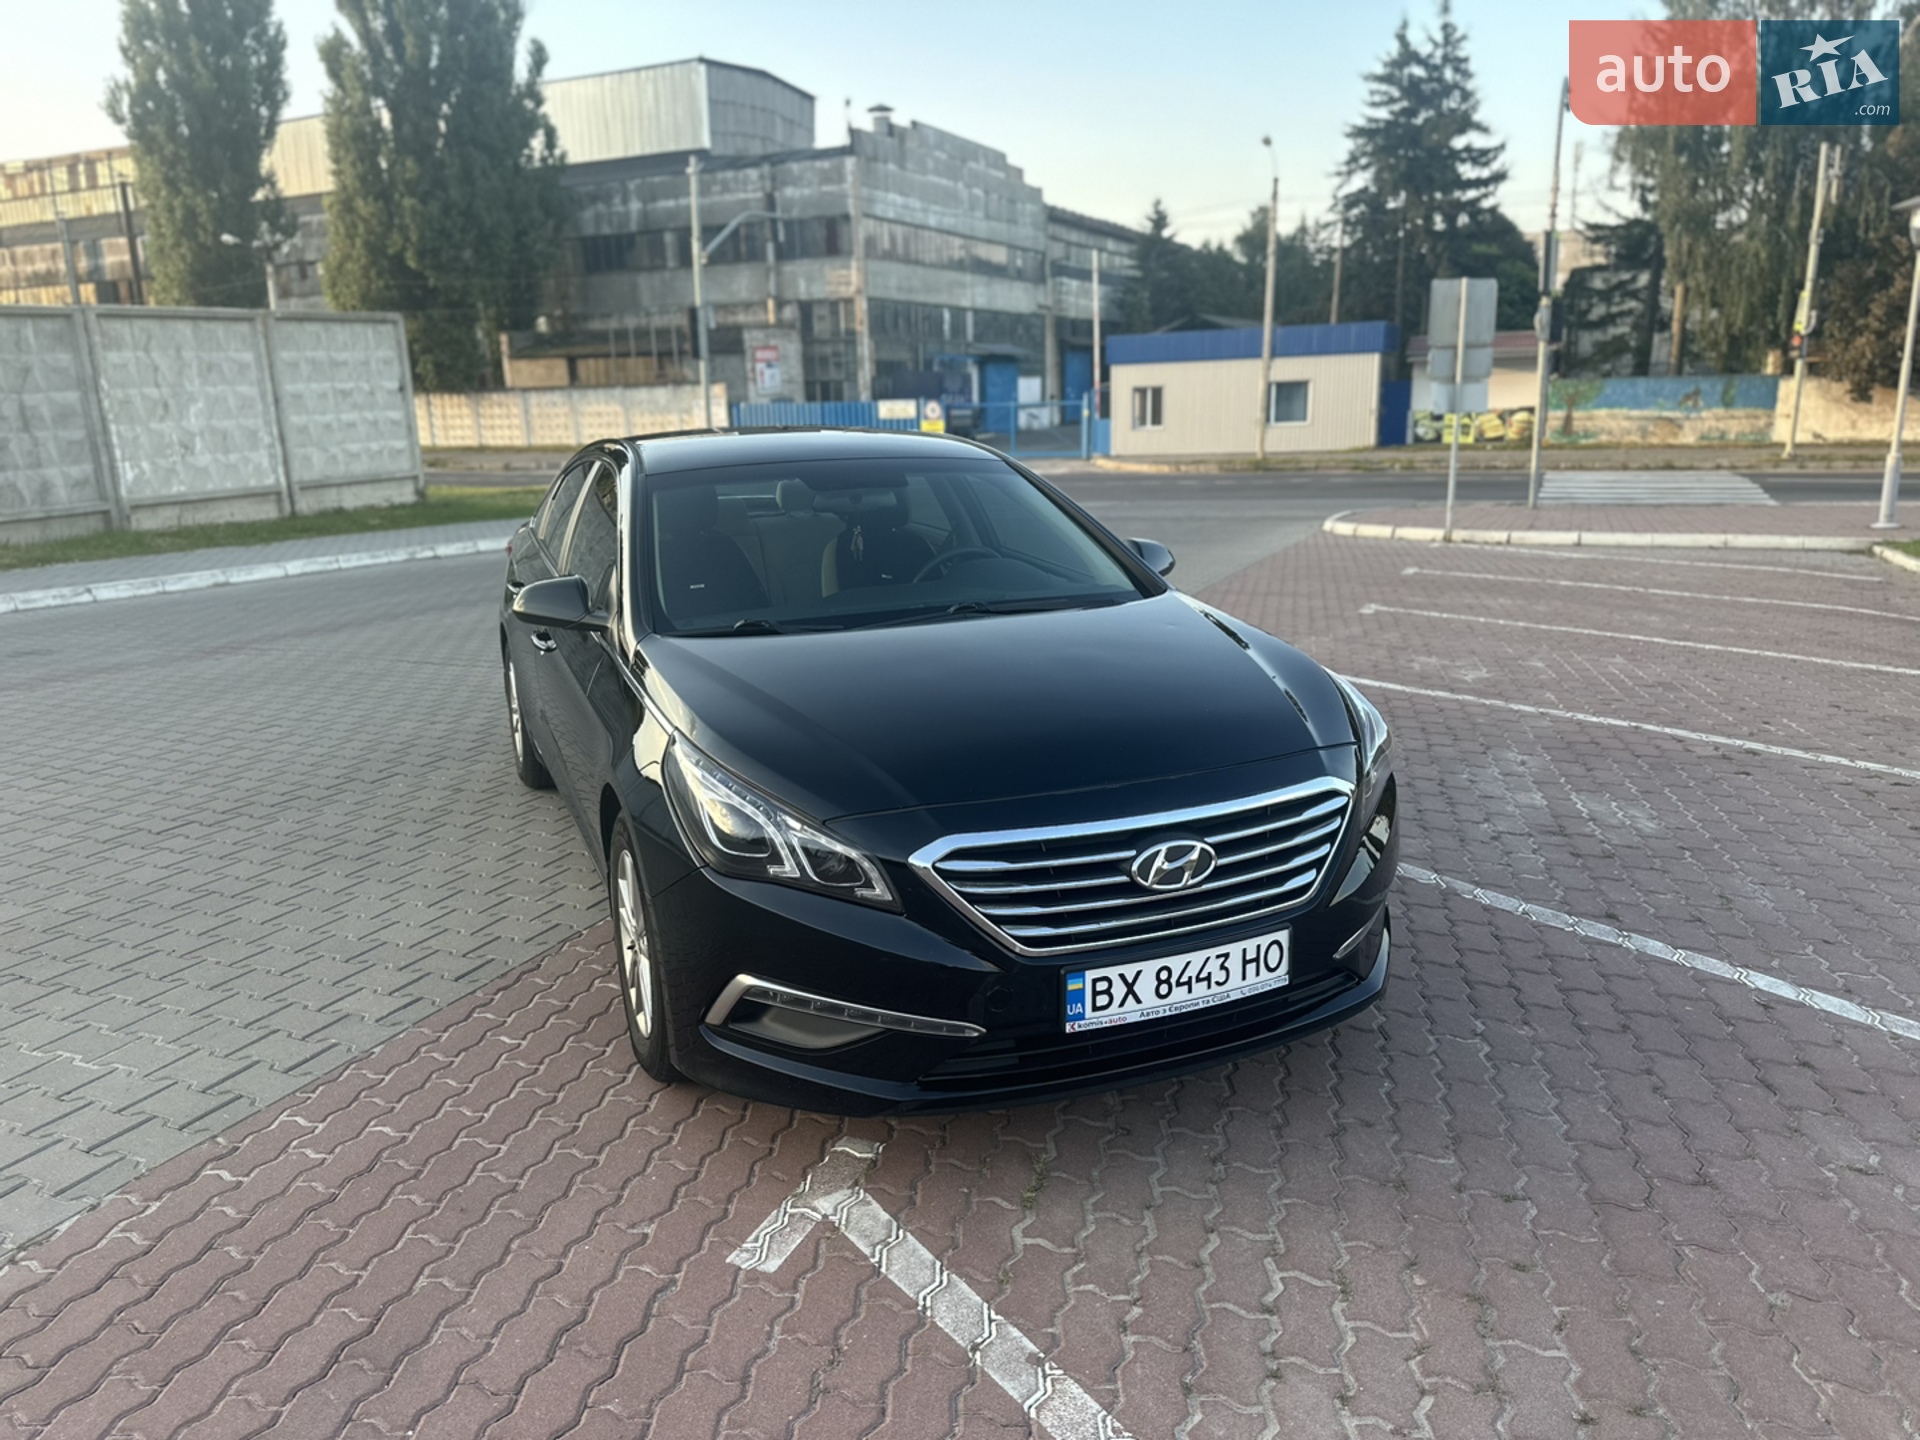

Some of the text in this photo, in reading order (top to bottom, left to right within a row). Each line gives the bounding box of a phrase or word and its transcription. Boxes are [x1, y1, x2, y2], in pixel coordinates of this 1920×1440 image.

[1091, 969, 1143, 1013] BX
[1154, 952, 1231, 1000] 8443
[1241, 939, 1285, 982] HO
[1067, 1003, 1084, 1015] UA
[1139, 1009, 1161, 1018] Авто
[1168, 1001, 1200, 1012] Європи
